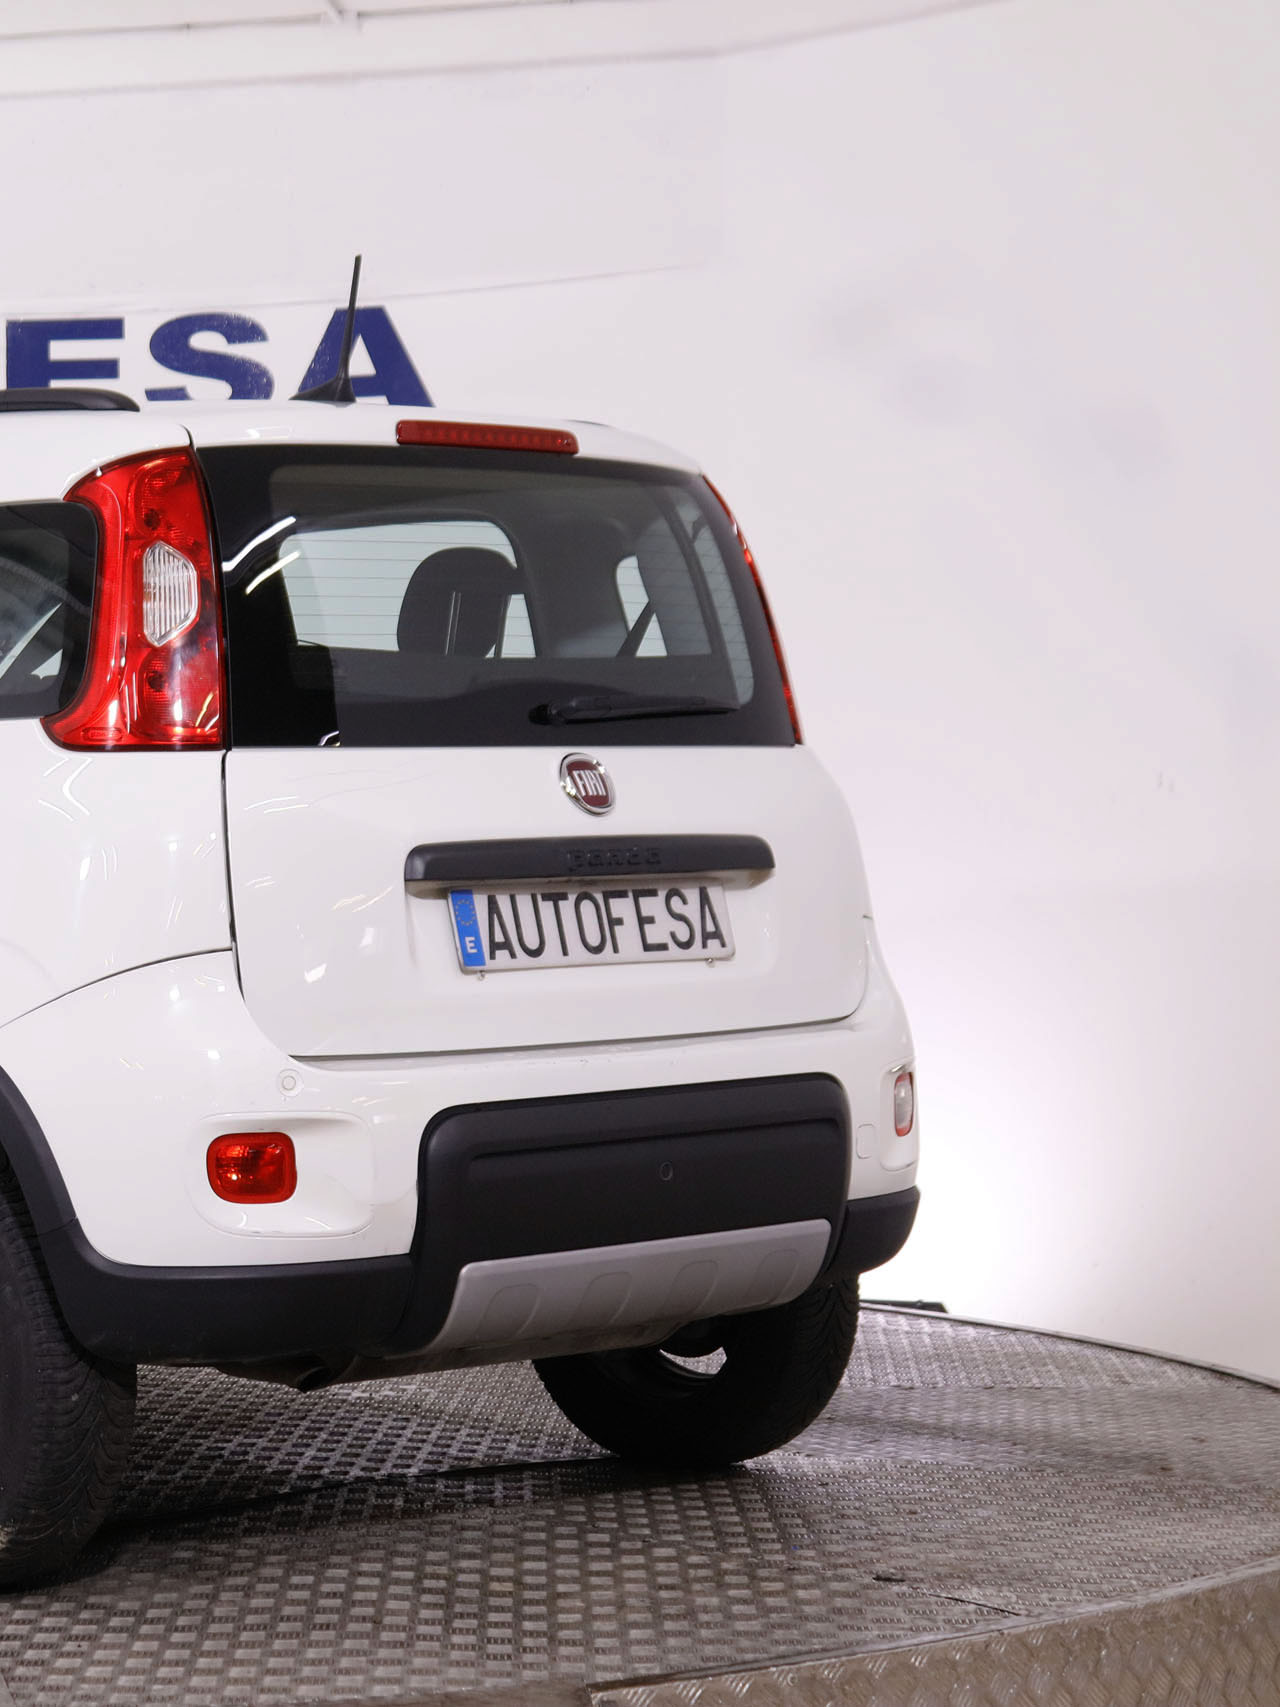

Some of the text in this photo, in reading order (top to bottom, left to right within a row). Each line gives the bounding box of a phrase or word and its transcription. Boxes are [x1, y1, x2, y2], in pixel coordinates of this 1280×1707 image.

[572, 769, 606, 796] FIAT
[464, 886, 727, 960] E AUTOFESA
